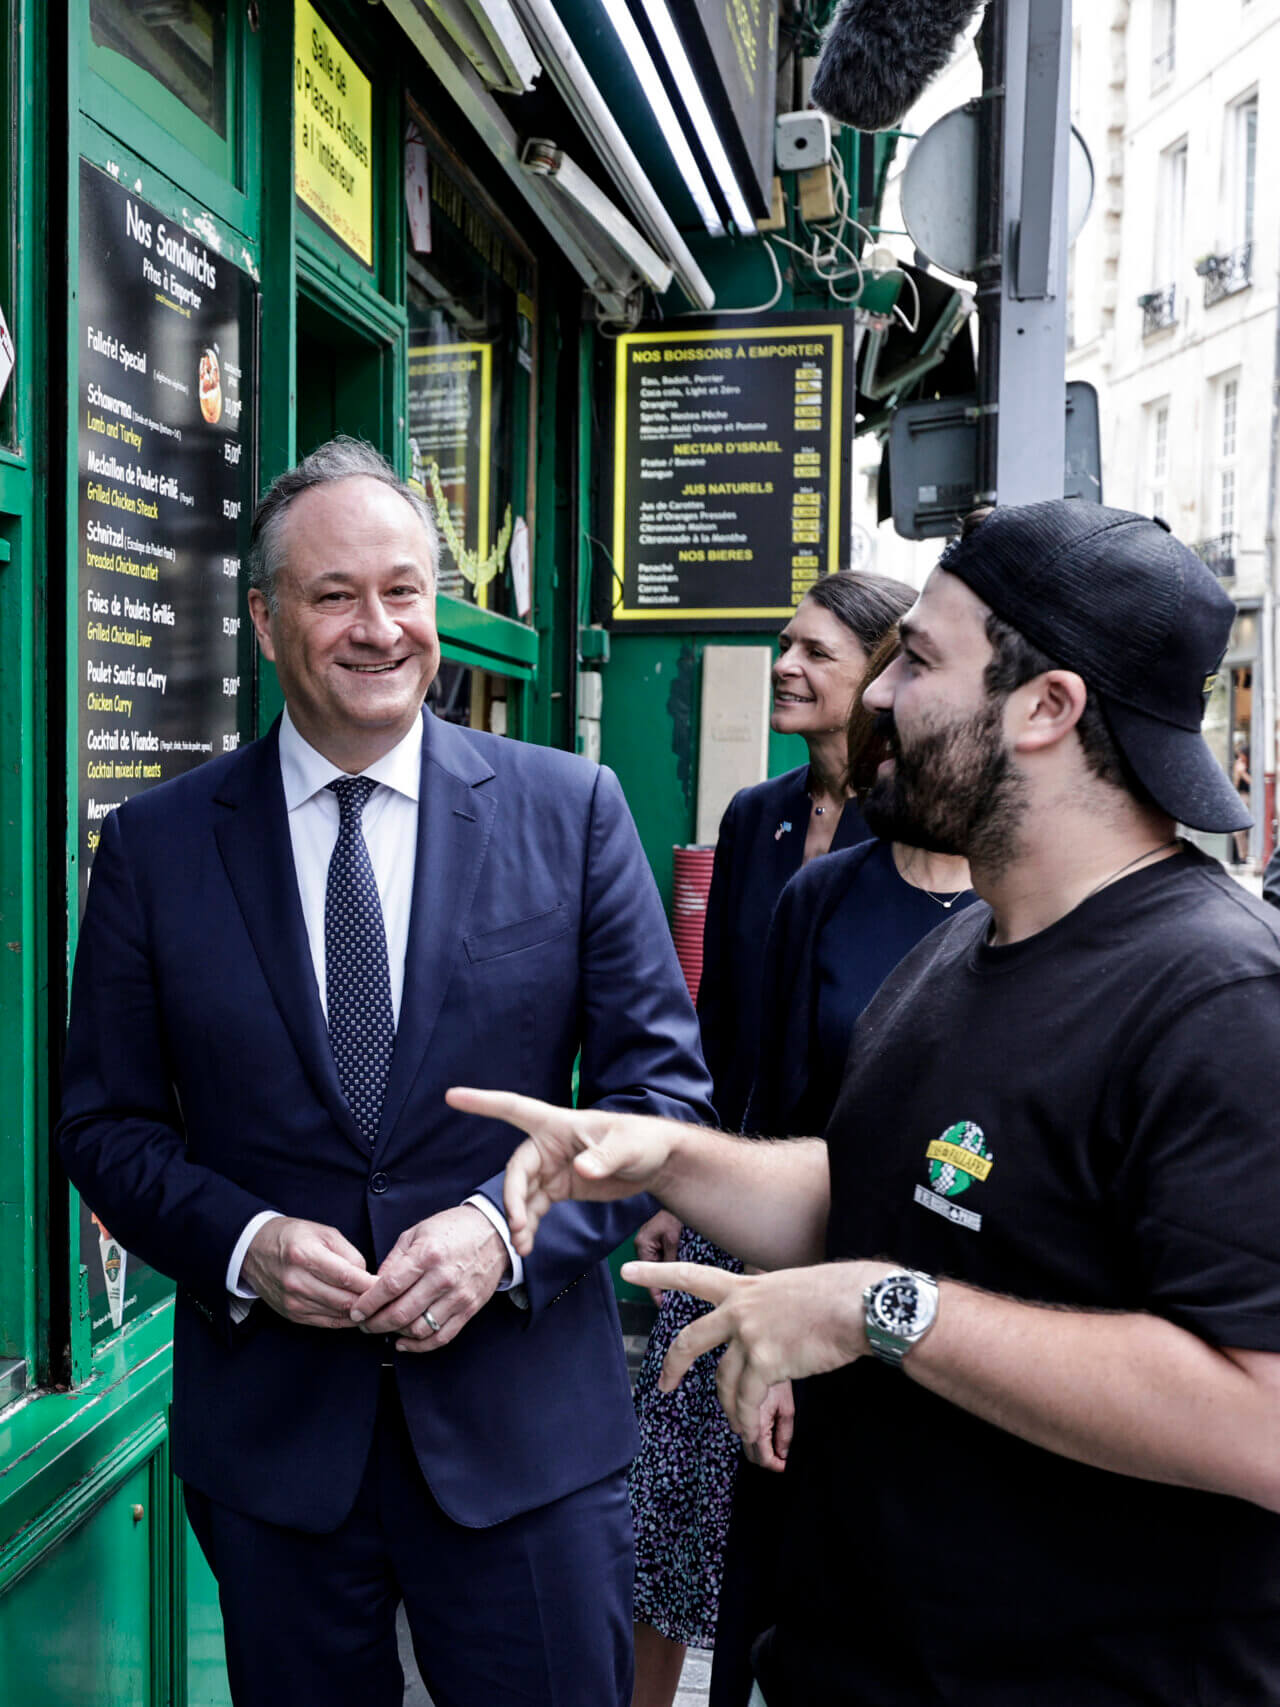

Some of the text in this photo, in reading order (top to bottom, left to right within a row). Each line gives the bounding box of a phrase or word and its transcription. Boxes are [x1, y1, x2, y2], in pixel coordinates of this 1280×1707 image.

[311, 27, 333, 81] Salle
[305, 66, 334, 129] Places
[126, 200, 216, 290] Nos Sandwichs
[143, 257, 161, 286] Pitas
[170, 272, 201, 310] Emporter
[87, 326, 147, 375] Fallafel Special
[632, 343, 825, 363] NOS BOISSONS À EMPORTER
[87, 382, 132, 420] Schawarma
[685, 385, 707, 398] Light
[709, 386, 718, 396] et
[87, 411, 105, 434] Lamb
[106, 419, 119, 441] and
[120, 421, 142, 453] Turkey
[724, 422, 734, 432] et
[673, 441, 782, 456] NECTAR D'ISRAEL
[125, 465, 135, 485] de
[136, 467, 158, 493] Poulet
[681, 482, 773, 496] JUS NATURELS
[87, 481, 111, 508] Grilled
[111, 486, 137, 514] Chicken
[87, 520, 124, 548] Schnitzel
[116, 553, 139, 578] Chicken
[679, 548, 753, 562] NOS BIERES
[87, 590, 175, 625] Foies de Poulets Grillés
[87, 622, 152, 649] Grilled Chicken Liver
[87, 660, 167, 695] Poulet Sauté au Curry
[87, 693, 132, 718] Chicken Curry
[87, 728, 119, 751] Cocktail
[120, 730, 130, 751] de
[131, 731, 159, 752] Viandes
[87, 761, 114, 780] Cocktail
[114, 761, 134, 779] mixed
[143, 763, 161, 779] meats
